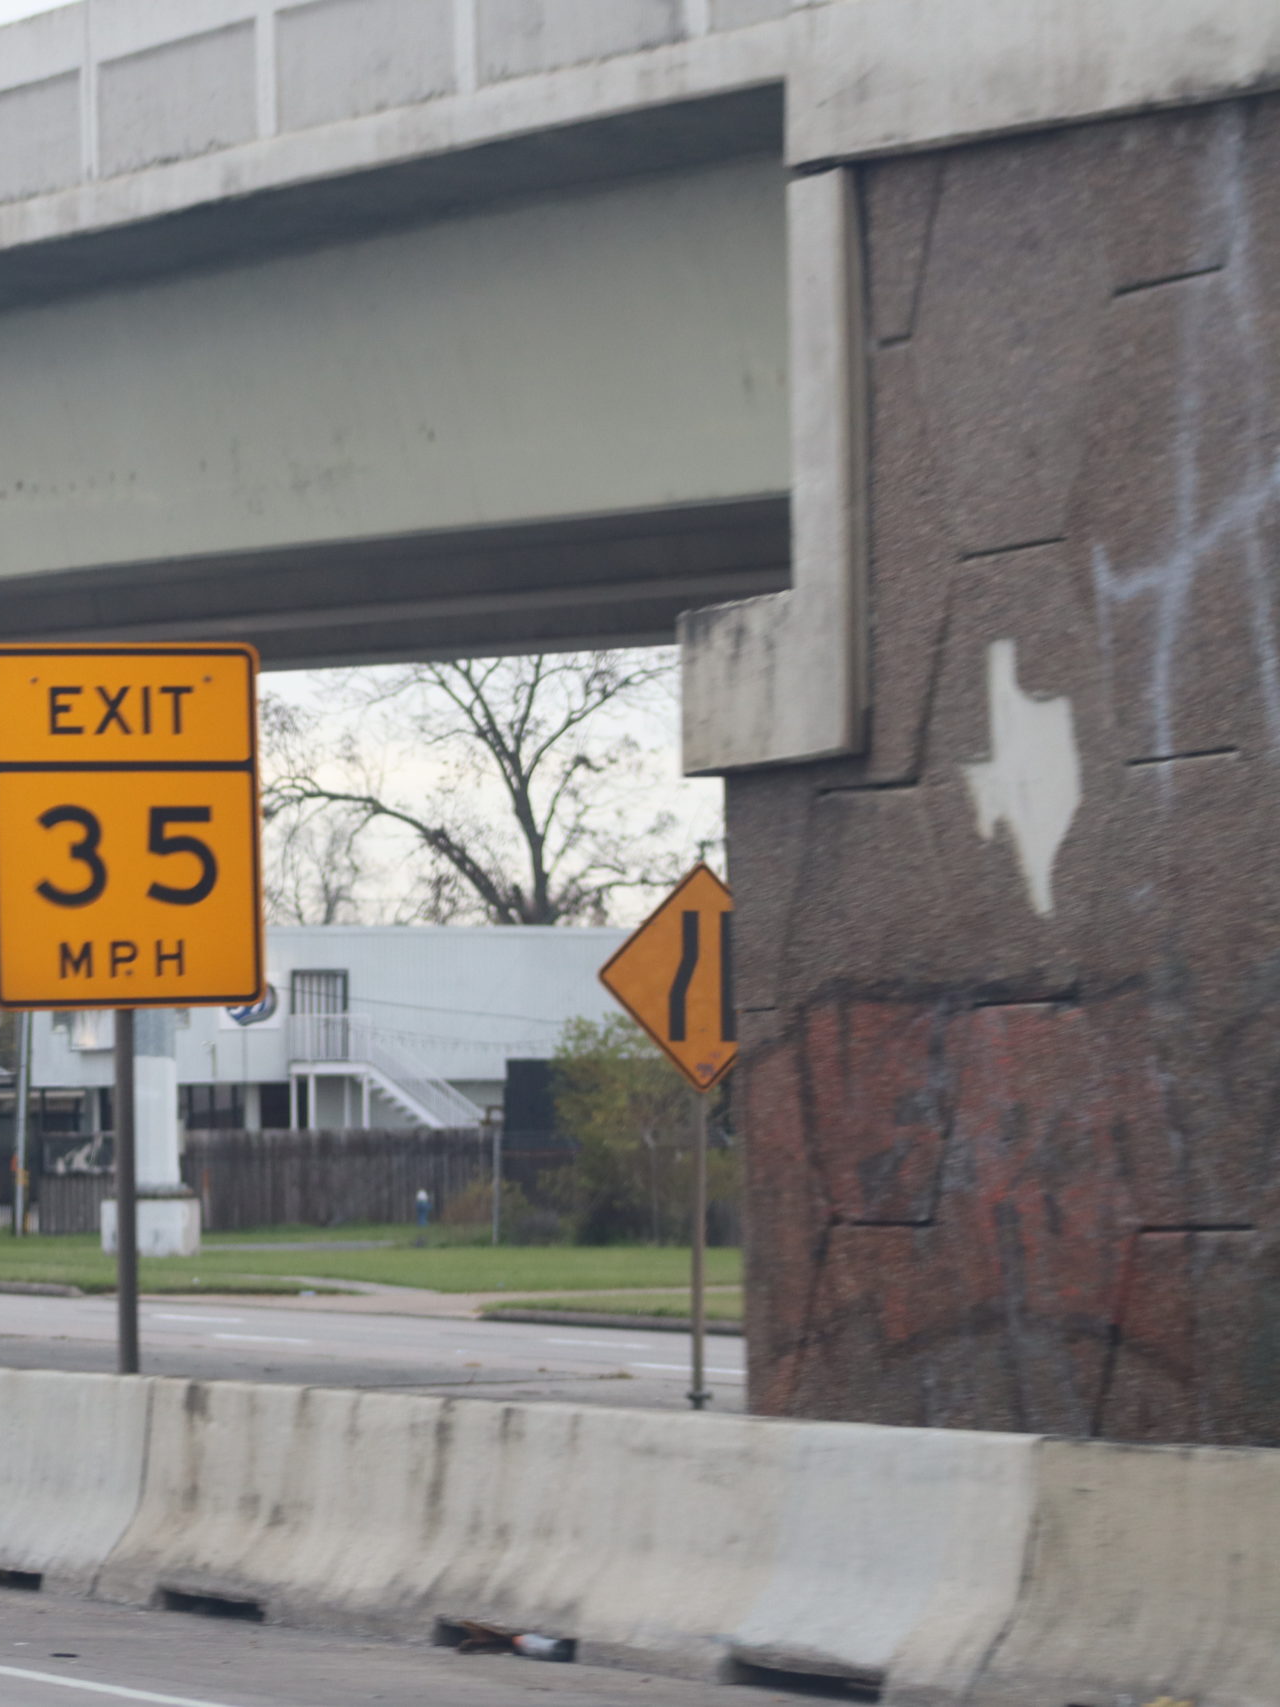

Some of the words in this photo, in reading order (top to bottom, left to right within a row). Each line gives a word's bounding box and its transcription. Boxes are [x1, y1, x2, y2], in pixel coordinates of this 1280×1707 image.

[48, 686, 194, 735] EXIT
[36, 804, 218, 909] 35
[59, 939, 186, 979] MPH
